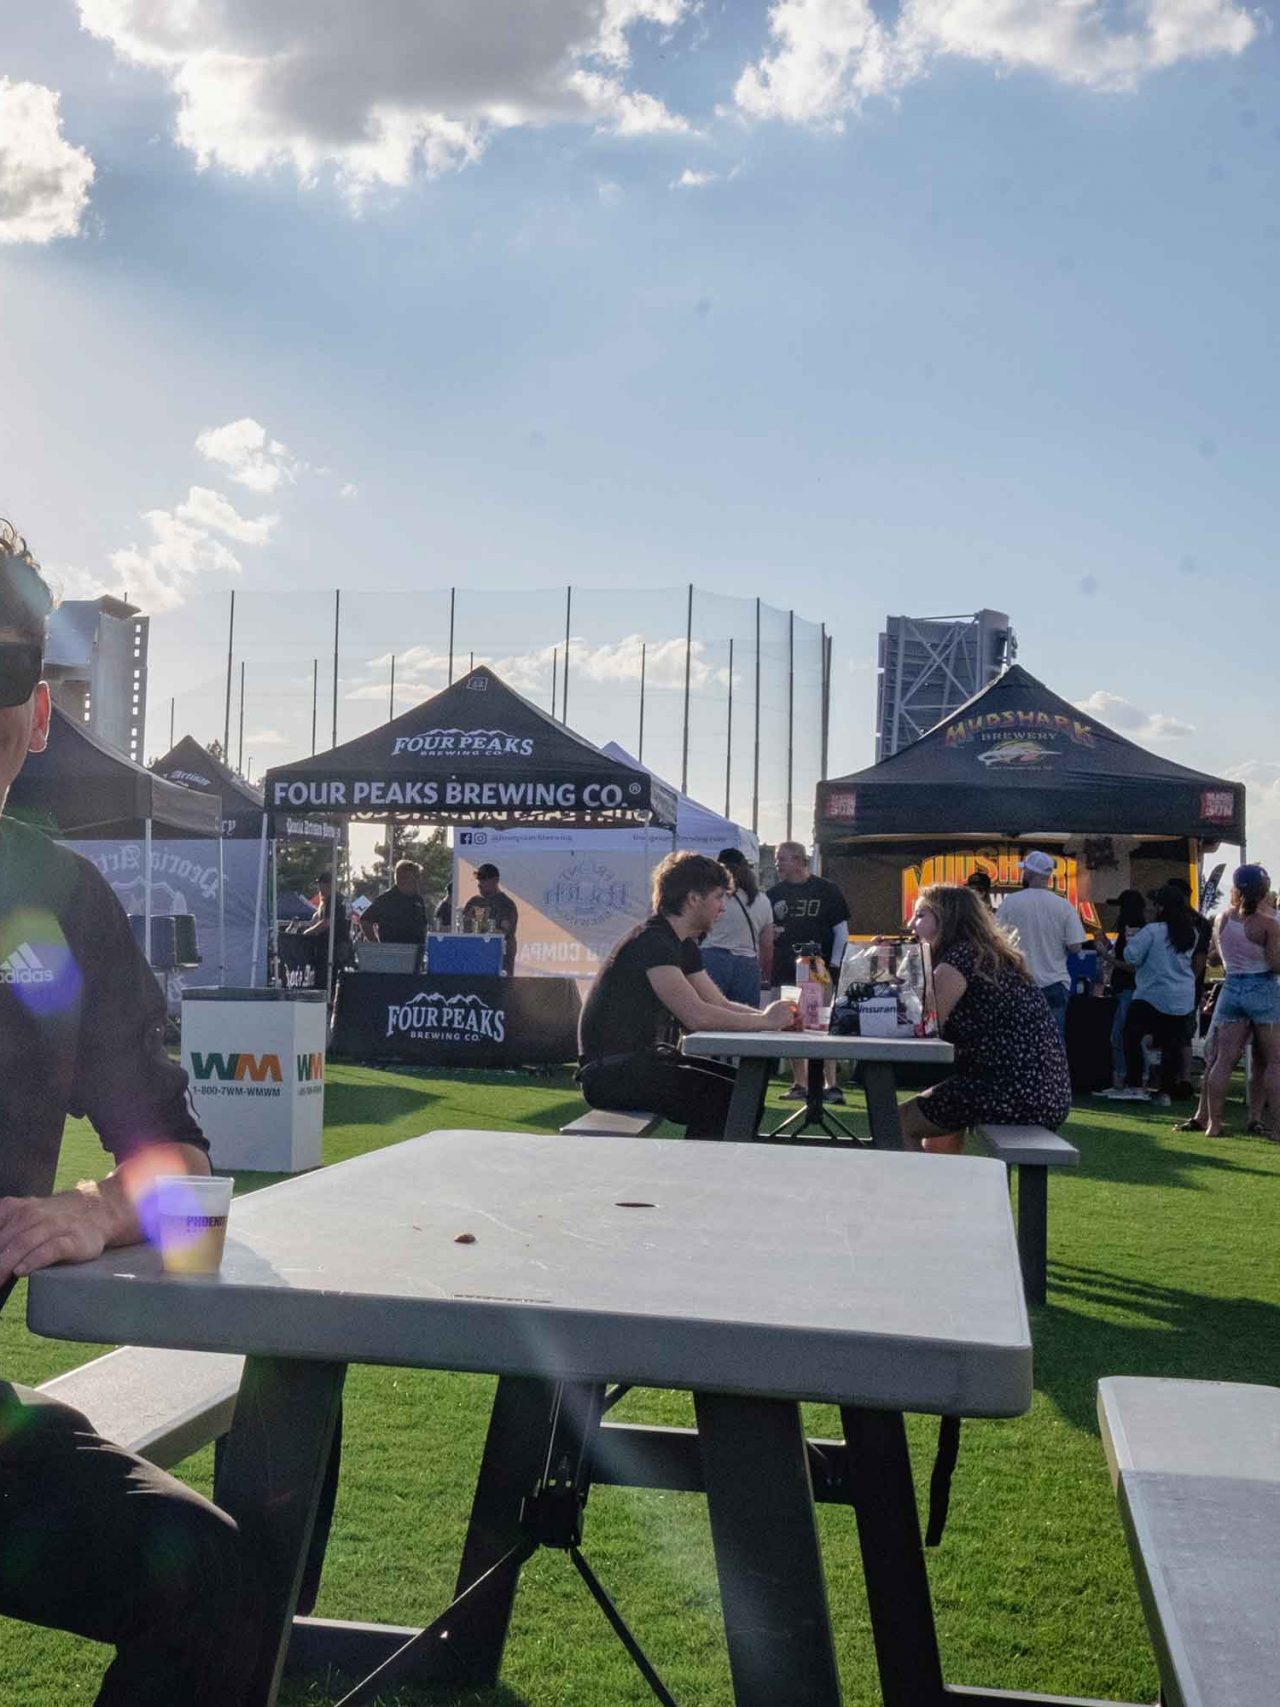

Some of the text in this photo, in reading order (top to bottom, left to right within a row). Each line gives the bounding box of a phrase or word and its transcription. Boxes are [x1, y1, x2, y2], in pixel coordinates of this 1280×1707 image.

[945, 711, 1096, 749] MUDSHARK
[981, 732, 1058, 741] BREWERY
[390, 736, 534, 756] FOUR PEAKS
[274, 781, 347, 806] FOUR
[354, 781, 438, 806] PEAKS
[443, 781, 576, 807] BREWING
[902, 846, 1102, 929] MUDSHRK
[386, 1005, 505, 1043] FOUR PEAKS
[410, 1031, 461, 1041] BREWING
[190, 1052, 284, 1083] WM
[192, 1086, 281, 1098] 1-800-7WM-WMWM
